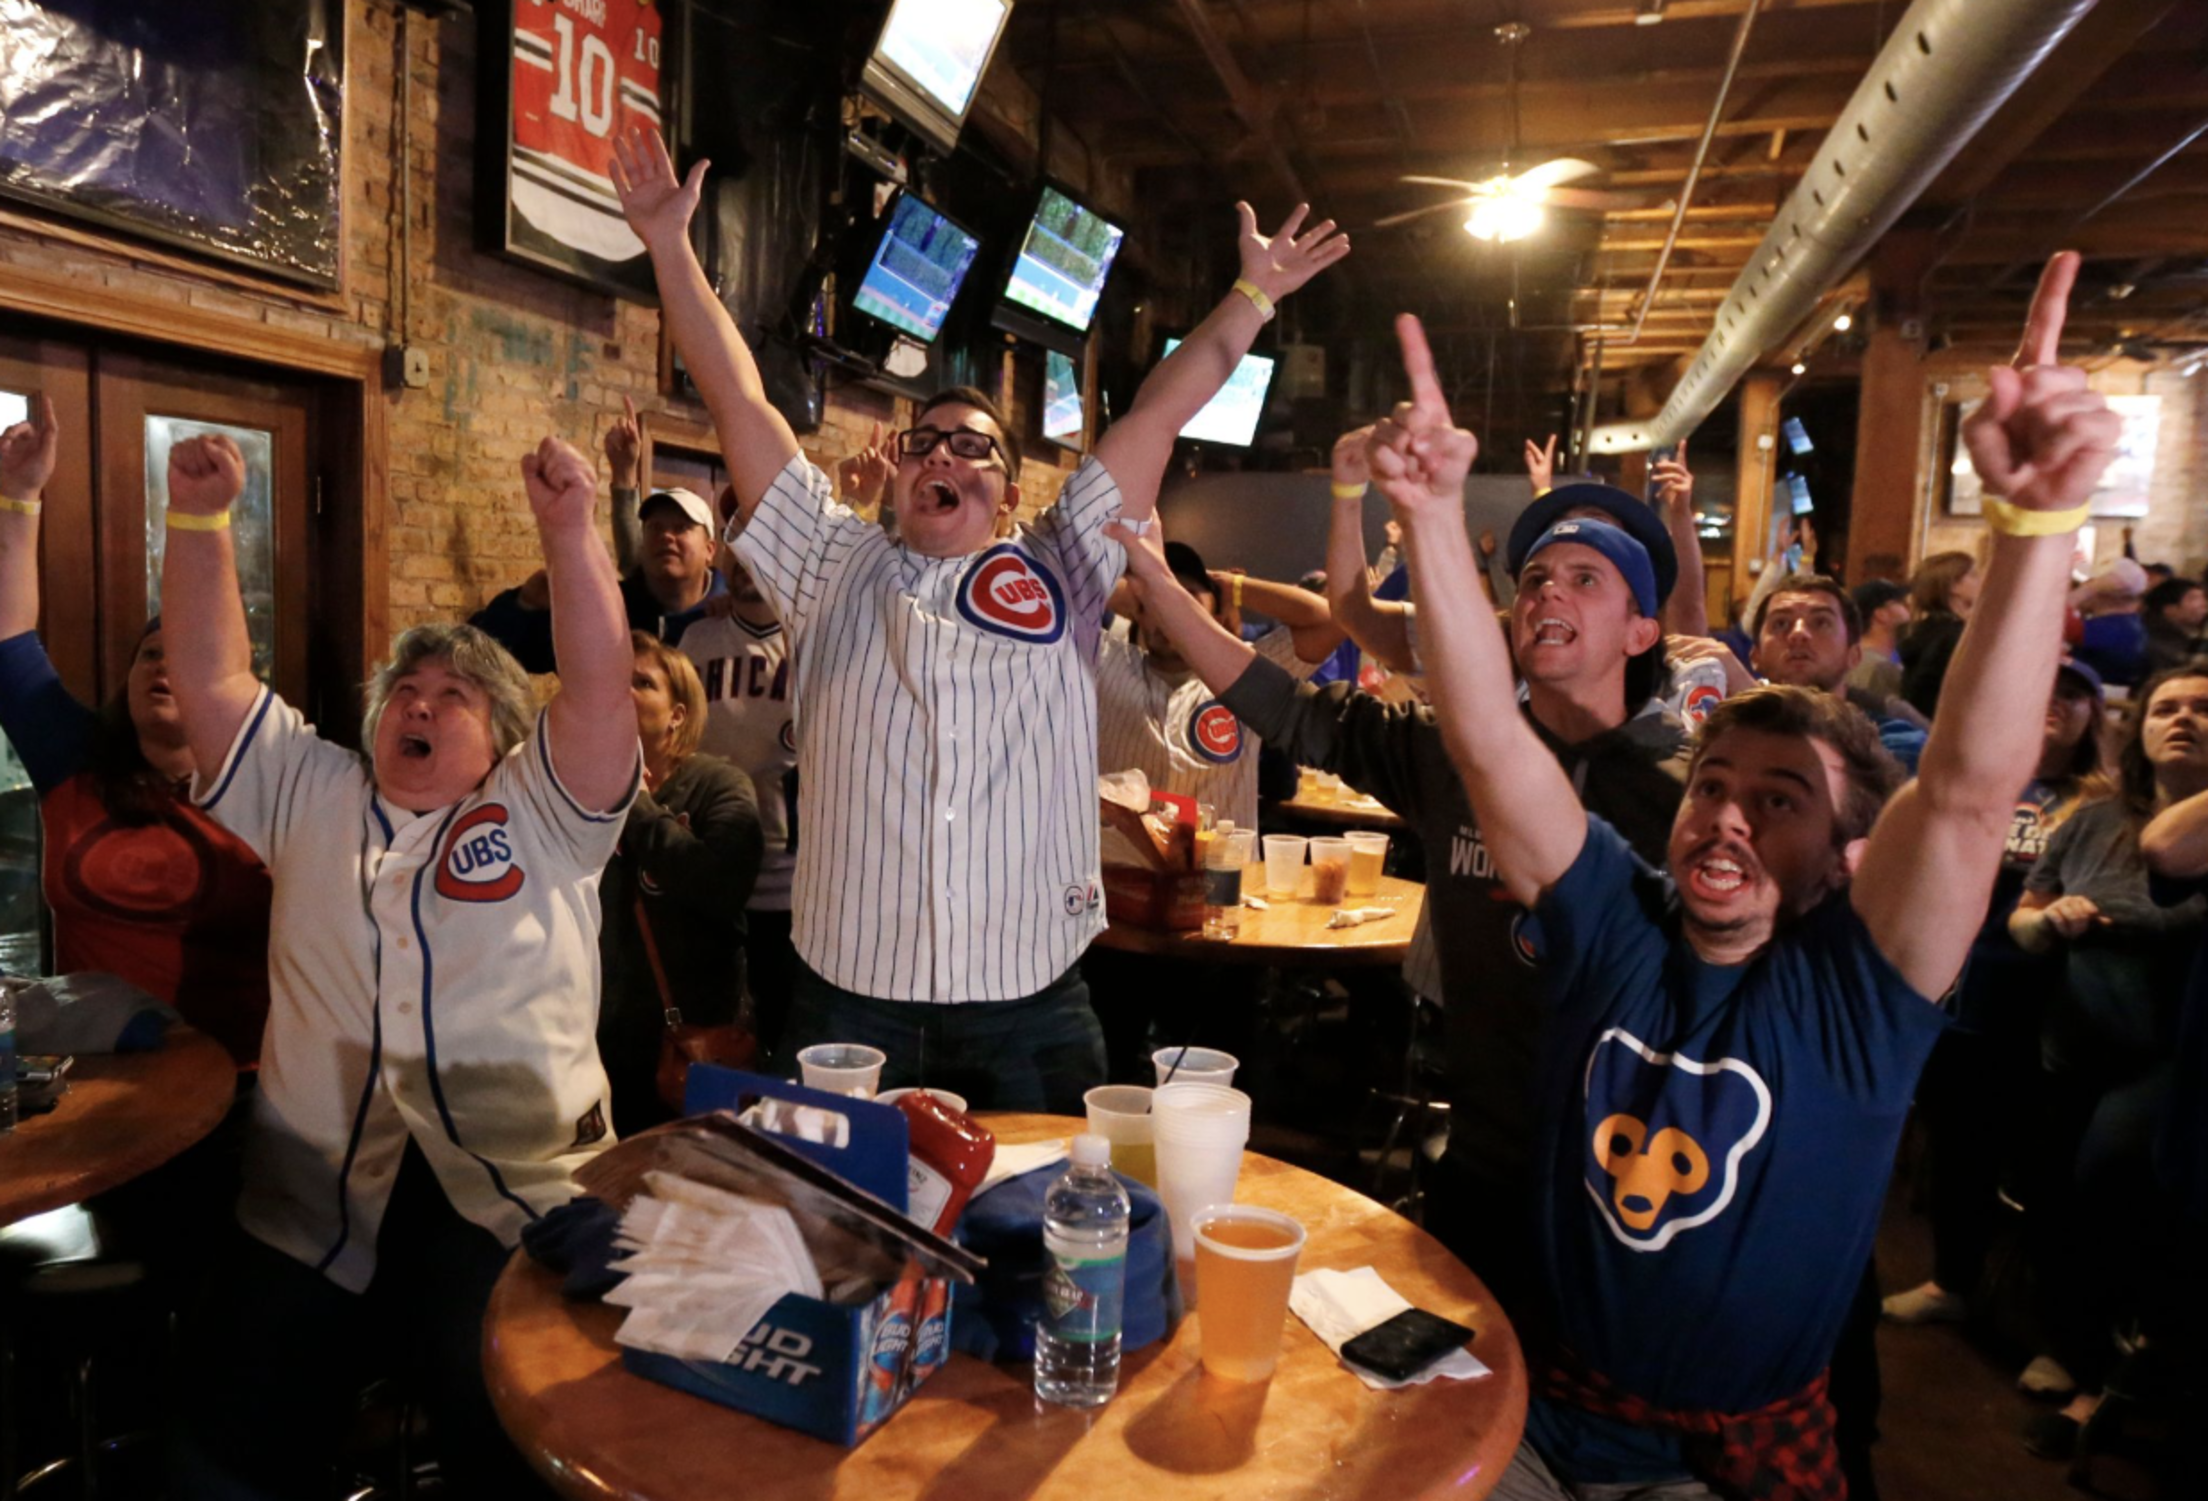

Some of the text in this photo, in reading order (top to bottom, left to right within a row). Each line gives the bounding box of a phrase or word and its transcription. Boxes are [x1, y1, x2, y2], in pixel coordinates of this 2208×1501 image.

[634, 27, 659, 70] 10
[550, 12, 615, 138] 10
[970, 556, 1052, 630] CUBS
[696, 654, 789, 704] HICA
[434, 802, 525, 902] CUBS
[744, 1323, 813, 1358] UD
[881, 1323, 912, 1338] BUD
